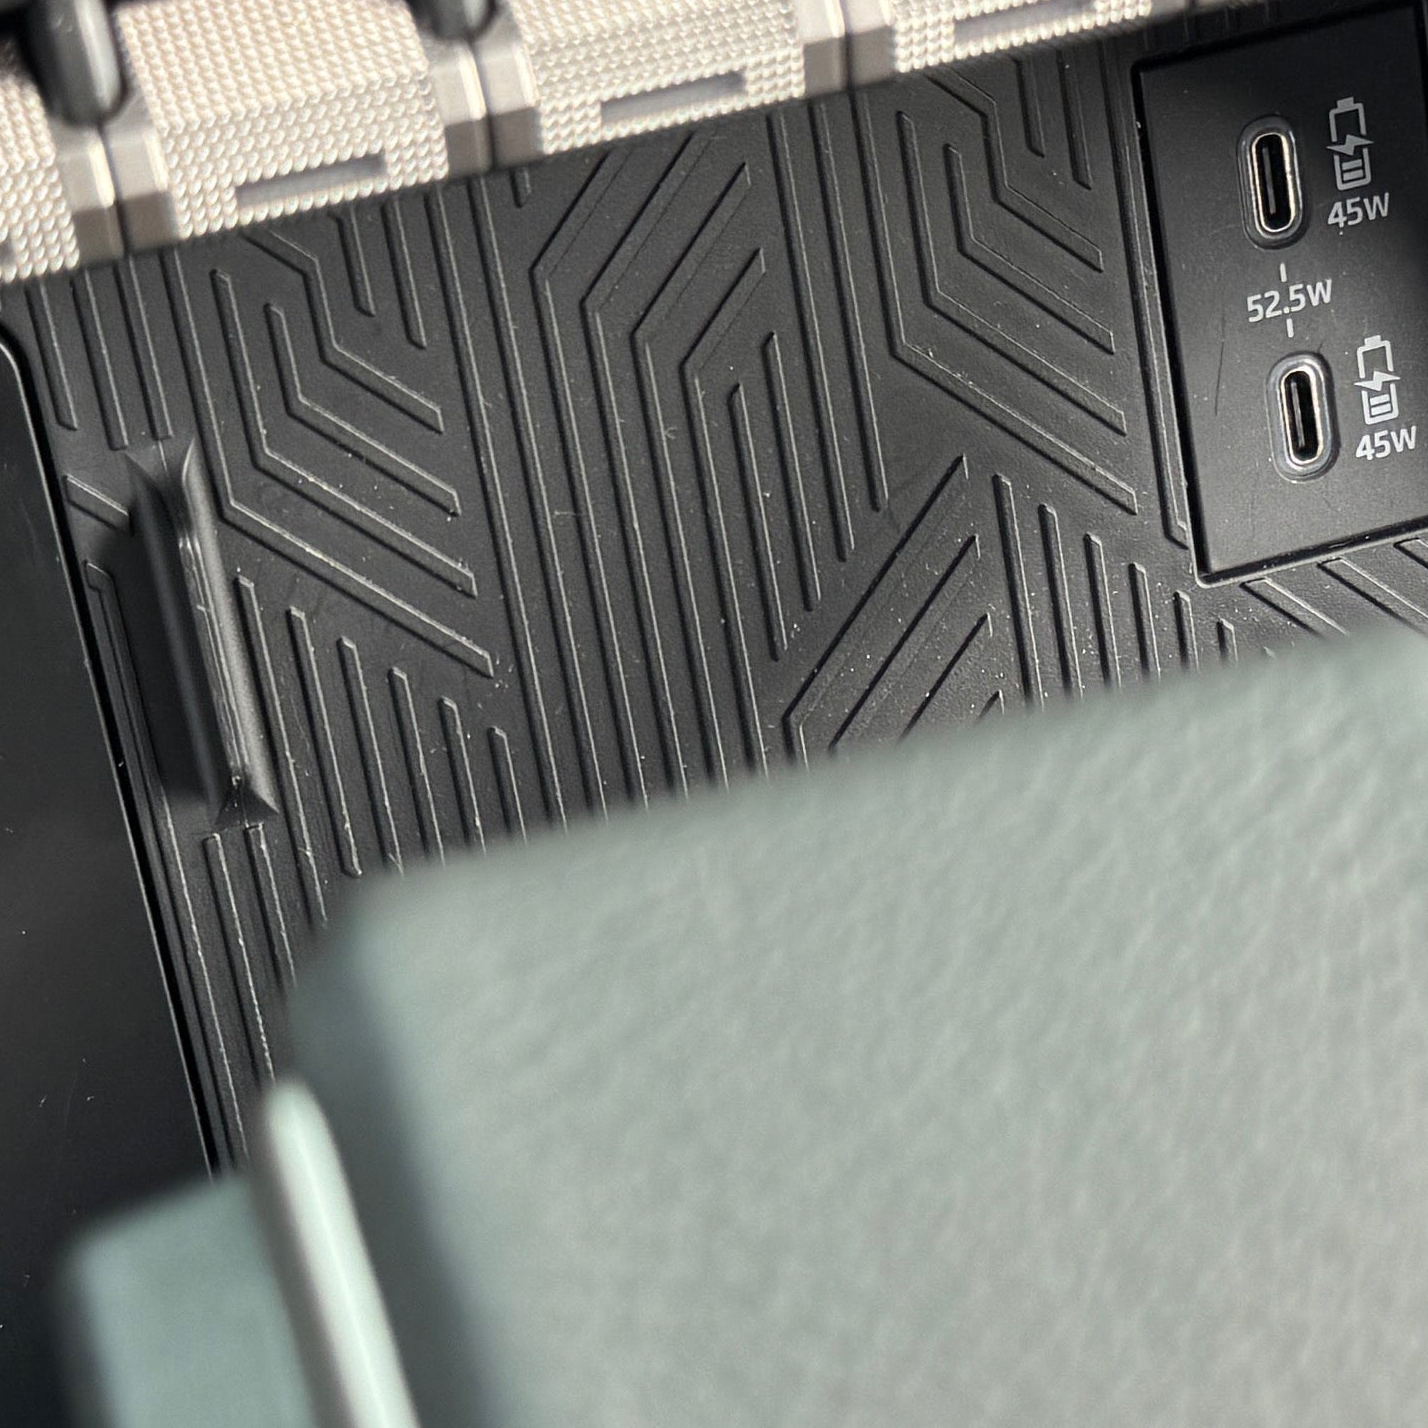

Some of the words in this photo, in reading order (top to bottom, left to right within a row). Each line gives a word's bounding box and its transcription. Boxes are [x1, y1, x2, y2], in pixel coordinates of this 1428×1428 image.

[1327, 192, 1390, 229] 45W
[1246, 279, 1333, 324] 52.5W
[1355, 425, 1417, 462] 45W
